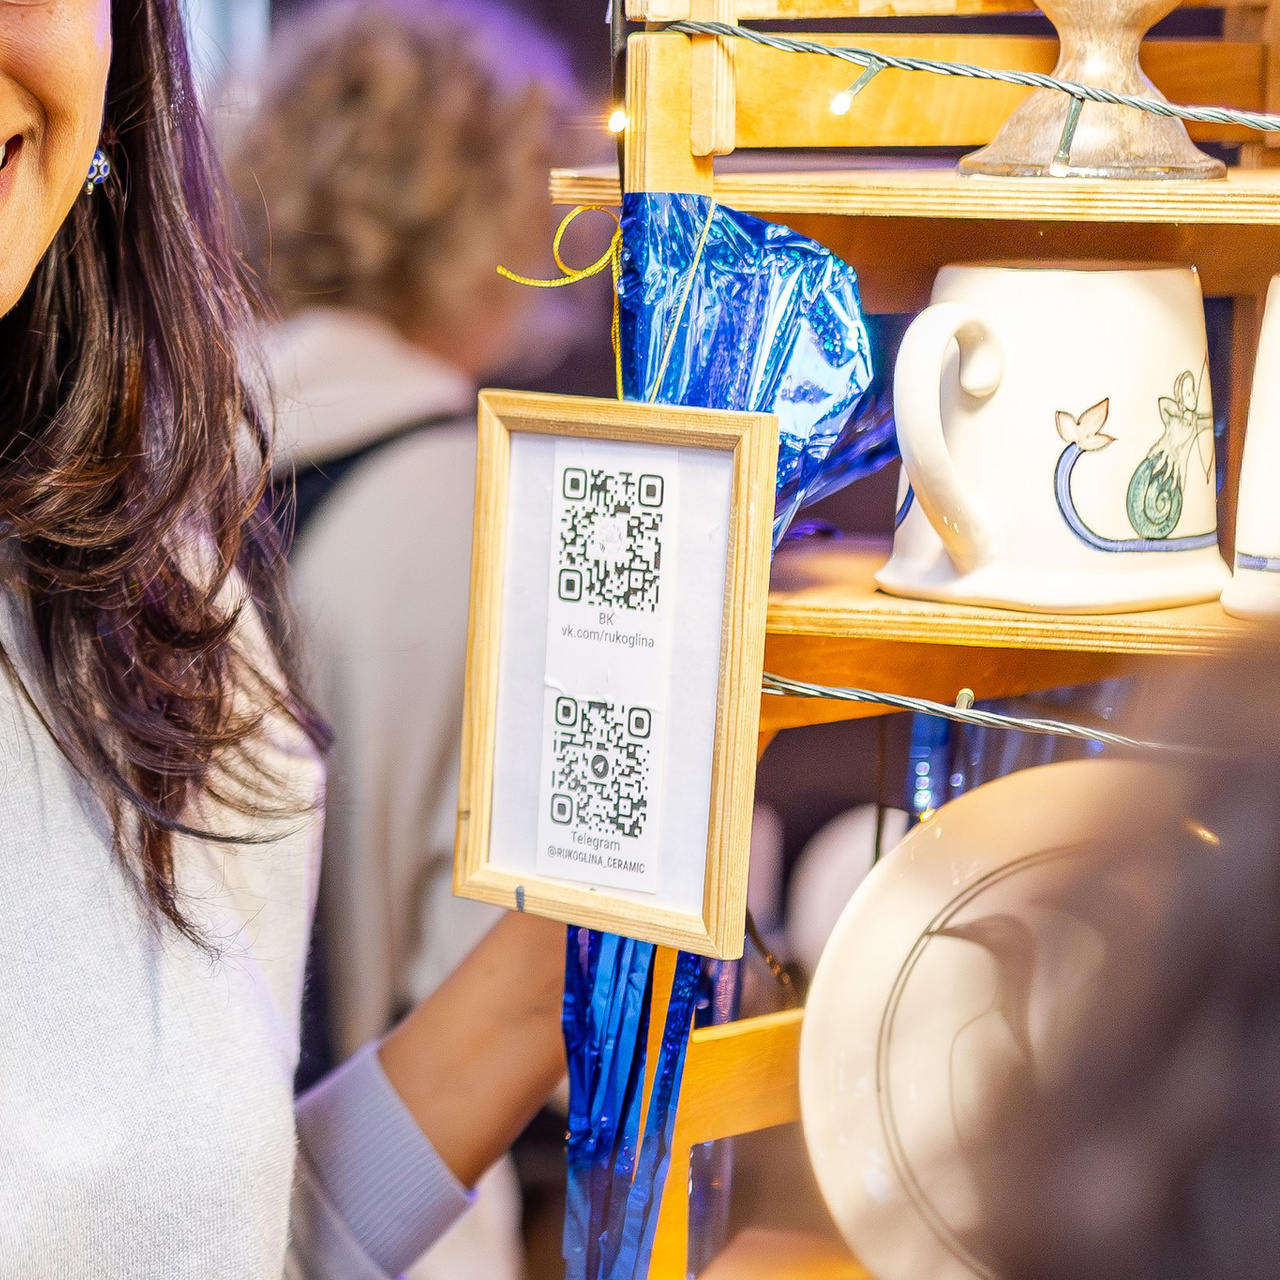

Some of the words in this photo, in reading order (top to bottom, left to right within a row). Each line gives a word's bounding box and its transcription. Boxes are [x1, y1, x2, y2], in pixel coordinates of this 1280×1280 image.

[561, 624, 655, 649] vk.com/rukoglina
[570, 830, 621, 852] Telegram
[547, 845, 646, 874] @RUKOGLINA_CERAMIC
